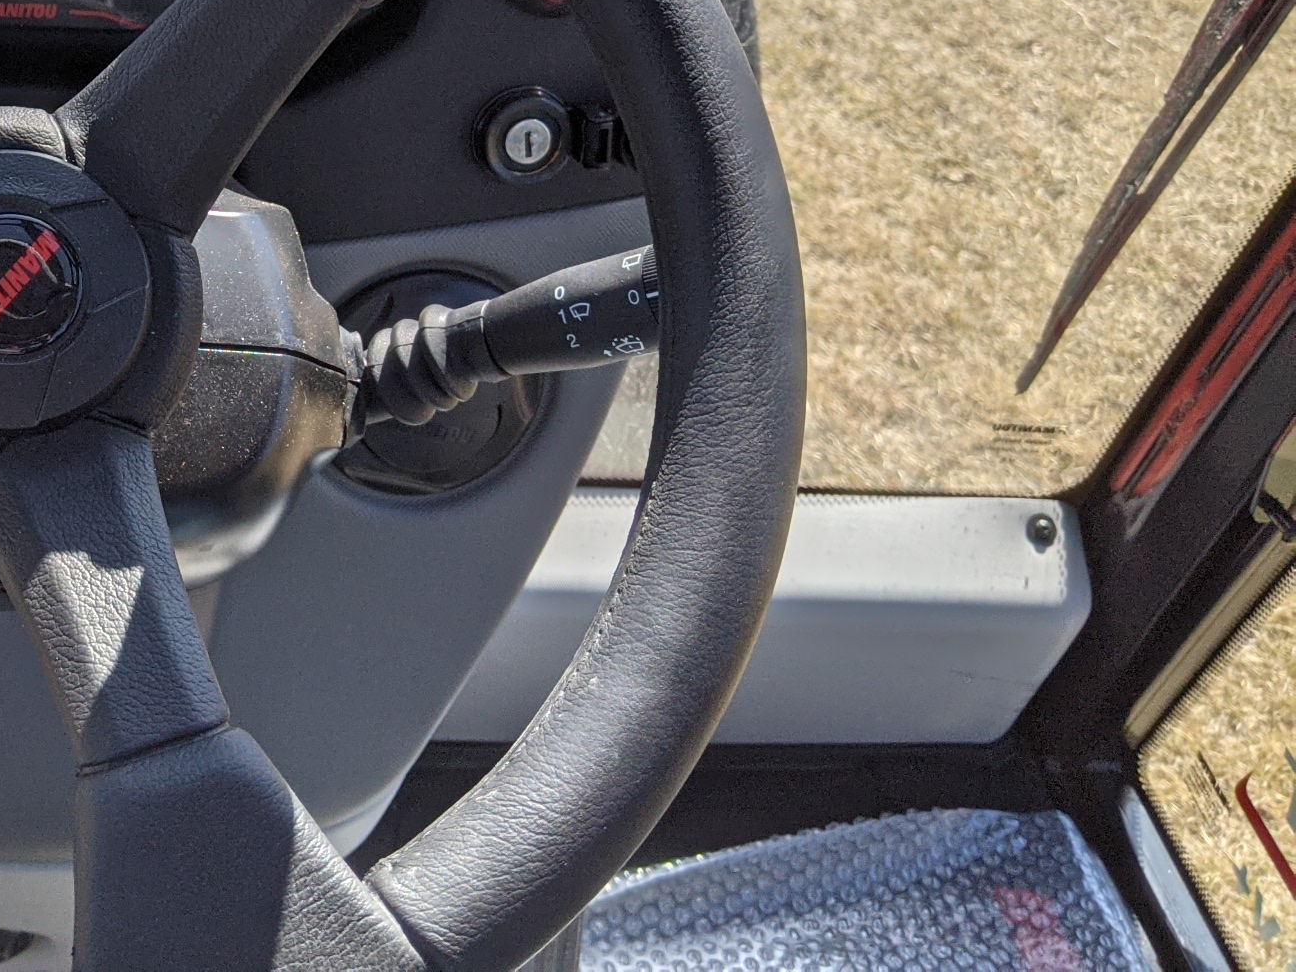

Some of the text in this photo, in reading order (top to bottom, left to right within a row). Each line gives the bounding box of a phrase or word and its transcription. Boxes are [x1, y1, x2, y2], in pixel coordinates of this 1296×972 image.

[554, 286, 565, 300] 0
[627, 289, 640, 305] 0
[557, 308, 567, 324] 1
[566, 333, 580, 348] 2
